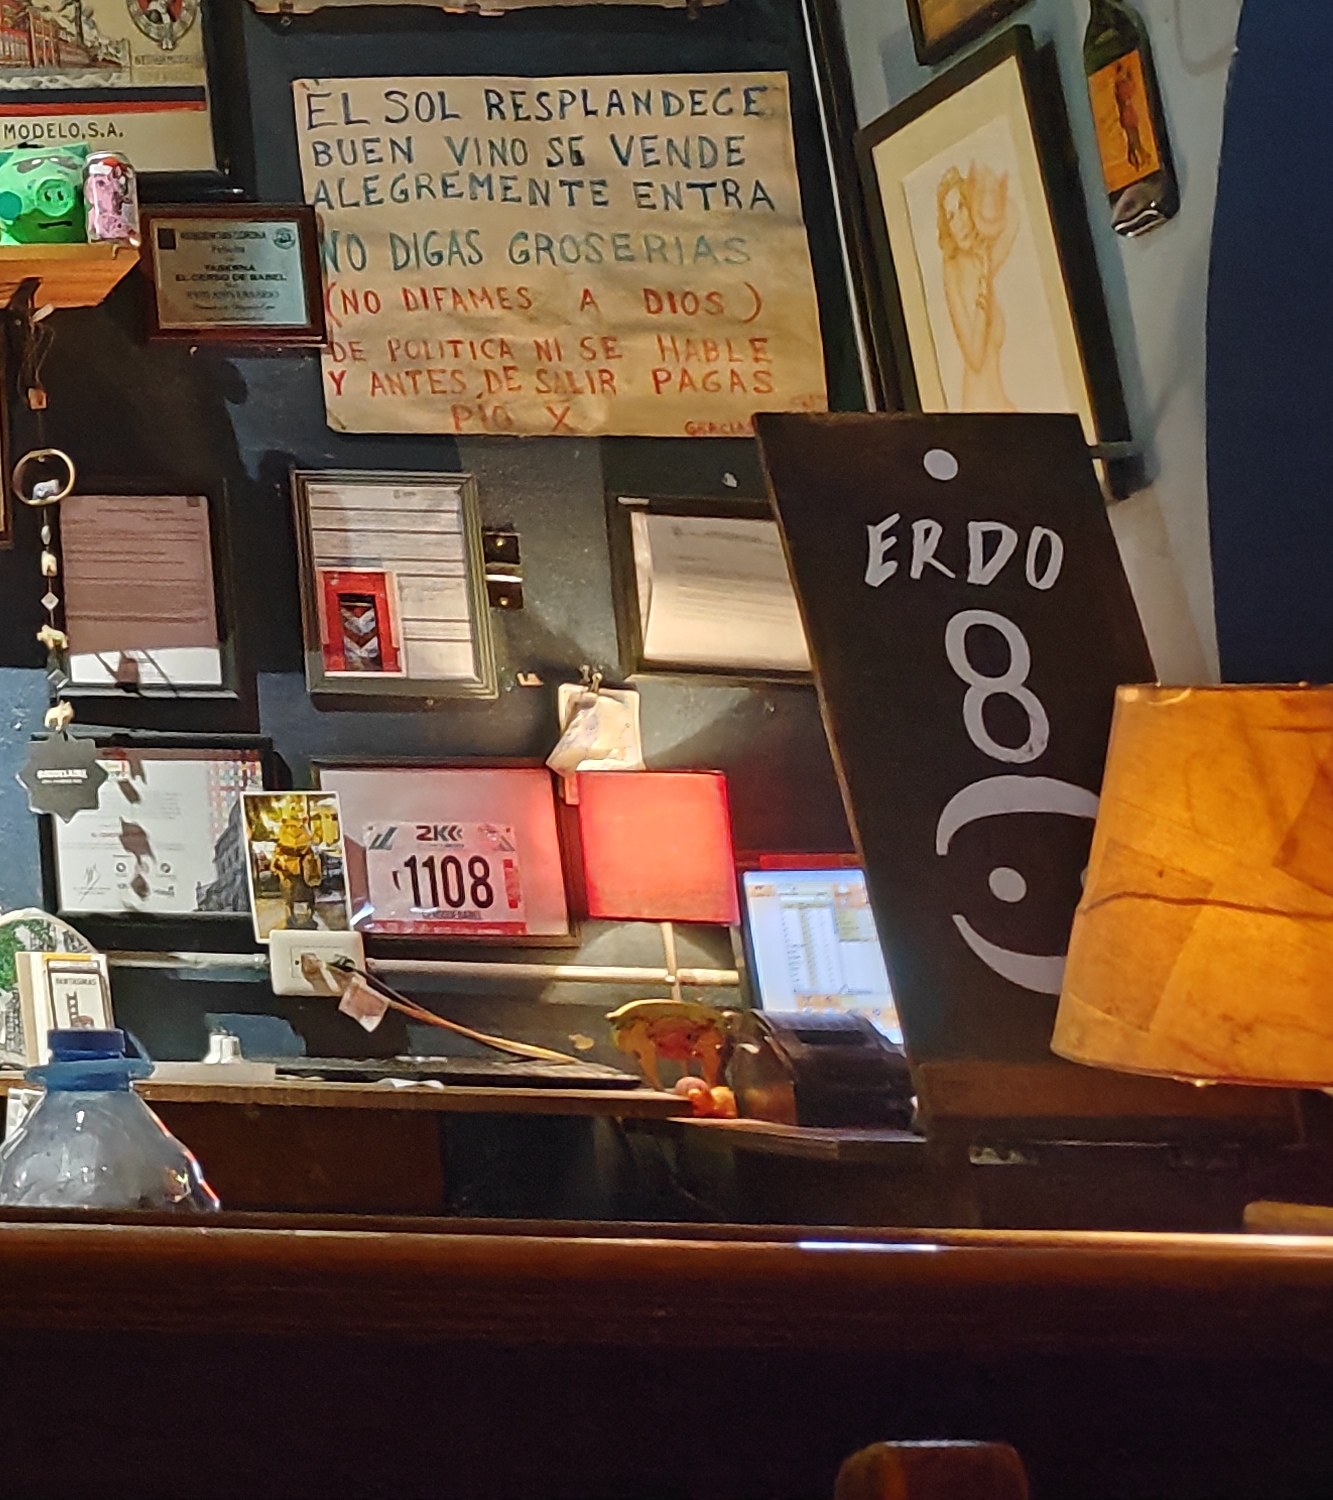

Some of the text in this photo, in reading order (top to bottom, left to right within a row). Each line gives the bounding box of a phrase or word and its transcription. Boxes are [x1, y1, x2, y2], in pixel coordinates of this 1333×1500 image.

[307, 86, 770, 131] EL SOL RESPLANDECE
[313, 133, 748, 169] BUEN VINO SE VENDE
[312, 170, 776, 212] ALEGREMENTE ENTRA
[319, 229, 752, 274] NO DIGAS GROSERIAS
[404, 286, 535, 316] DIFAMES
[579, 287, 601, 313] A
[329, 334, 774, 364] DE POLITICA NI SE HABLE
[328, 366, 775, 398] Y ANTES DE SALIR PAGAS
[545, 404, 573, 432] X
[864, 512, 1065, 591] ERDO
[403, 854, 495, 910] 1108
